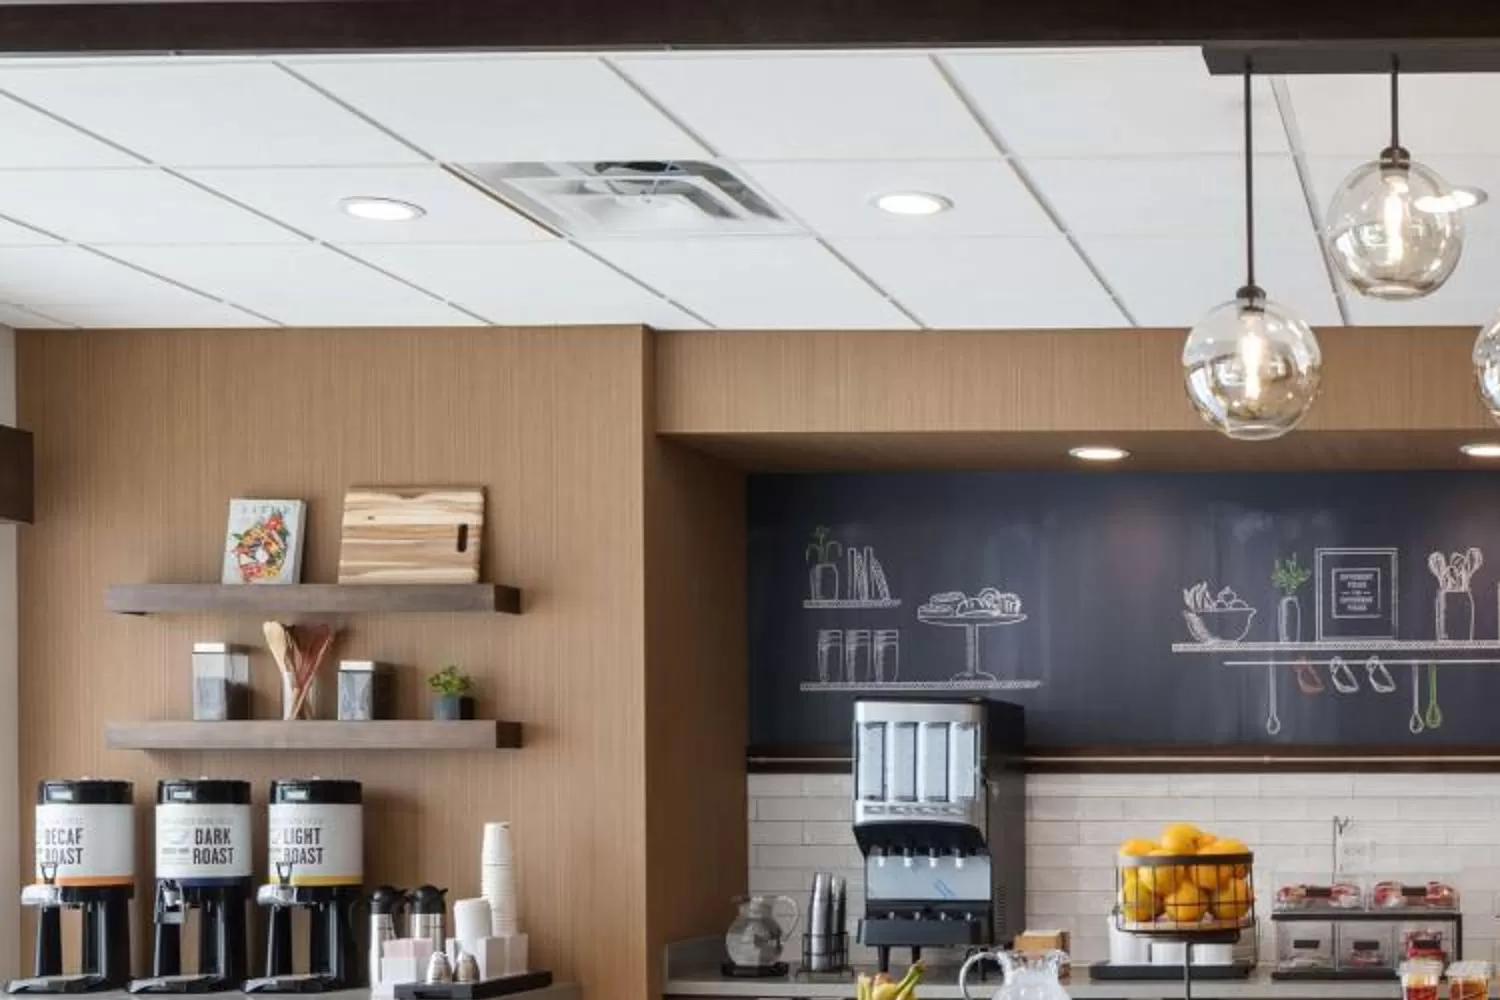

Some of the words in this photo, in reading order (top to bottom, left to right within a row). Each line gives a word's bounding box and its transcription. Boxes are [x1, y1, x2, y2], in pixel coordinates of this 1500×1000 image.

[44, 827, 84, 845] DECAF
[194, 827, 232, 845] DARK
[283, 827, 321, 845] LIGHT
[192, 847, 235, 865] ROAST
[283, 847, 324, 865] ROAST
